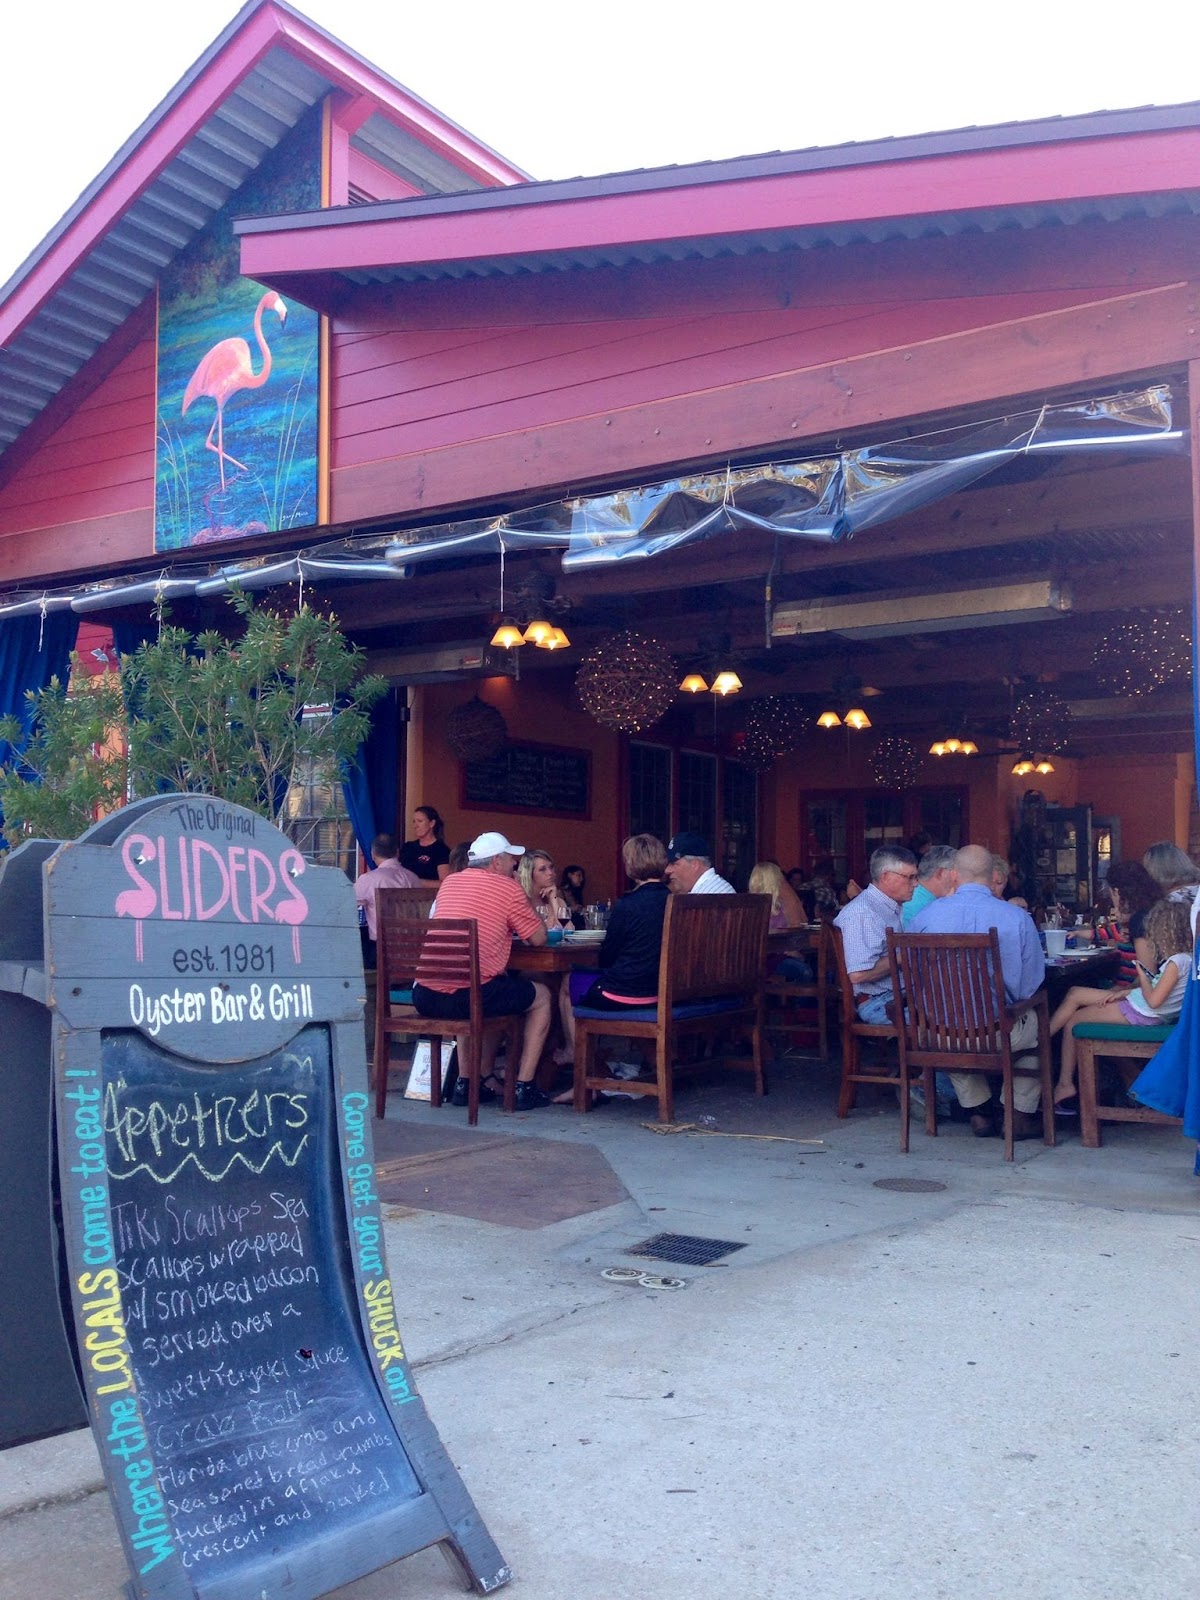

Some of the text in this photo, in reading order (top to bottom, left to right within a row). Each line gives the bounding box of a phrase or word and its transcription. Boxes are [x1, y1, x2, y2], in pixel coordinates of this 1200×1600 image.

[170, 803, 256, 841] The Original
[115, 834, 308, 926] SLIDERS
[129, 983, 313, 1036] Oyster Bar & Grill
[102, 1083, 309, 1162] Appetizers
[71, 1142, 107, 1180] to
[80, 1185, 116, 1266] come
[269, 1192, 310, 1223] Sea
[209, 1226, 303, 1269] wrapped
[342, 1091, 418, 1407] Come get your SHUCK on!
[252, 1264, 320, 1294] bacon
[78, 1268, 134, 1396] LOCALS
[230, 1310, 273, 1338] over
[282, 1302, 302, 1316] a
[107, 1397, 147, 1461] the
[156, 1456, 232, 1493] Florida
[332, 1411, 377, 1435] and
[273, 1500, 312, 1527] and
